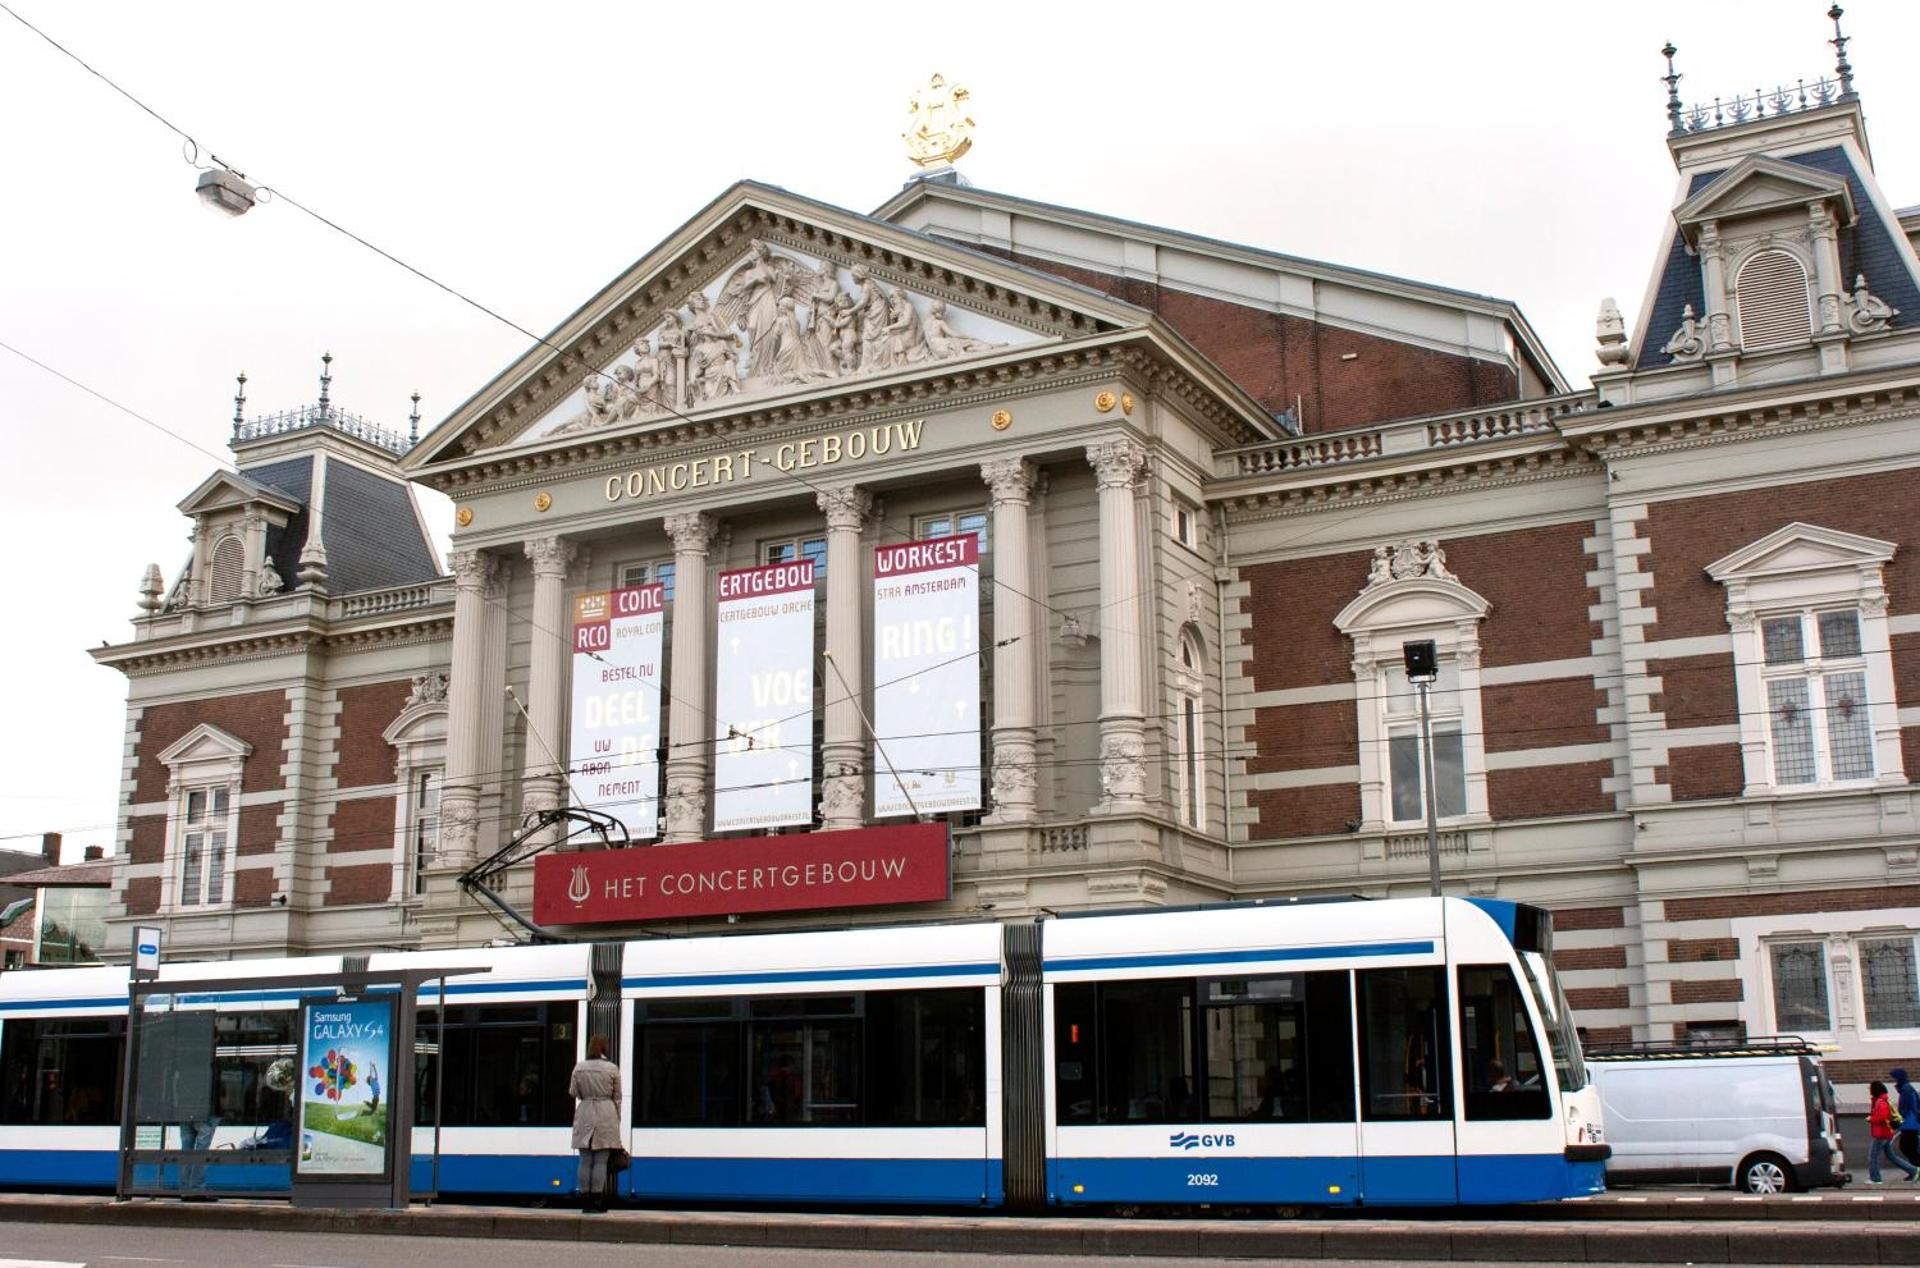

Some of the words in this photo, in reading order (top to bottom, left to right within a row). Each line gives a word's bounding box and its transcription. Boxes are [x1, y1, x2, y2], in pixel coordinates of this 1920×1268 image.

[877, 539, 968, 573] WORKEST
[719, 563, 813, 597] ERTGEBOU
[877, 586, 902, 601] STRA
[904, 576, 967, 597] AMSTERDAM
[618, 586, 662, 613] CONC
[719, 604, 779, 623] CERTGEBOUW
[781, 599, 813, 614] ORCHE
[577, 625, 608, 649] RCO
[601, 665, 637, 683] BESTEL
[639, 663, 654, 678] NU
[751, 669, 809, 708] VOE
[584, 691, 651, 729] DEEL
[594, 739, 612, 753] UW
[598, 780, 640, 798] NEMENT
[605, 876, 647, 899] HET
[660, 857, 907, 895] CONCERTGEBOUW
[314, 1011, 352, 1023] Samsung
[314, 1023, 363, 1039] GALAXY
[1201, 1134, 1235, 1147] GVB
[1187, 1174, 1219, 1186] 2092
